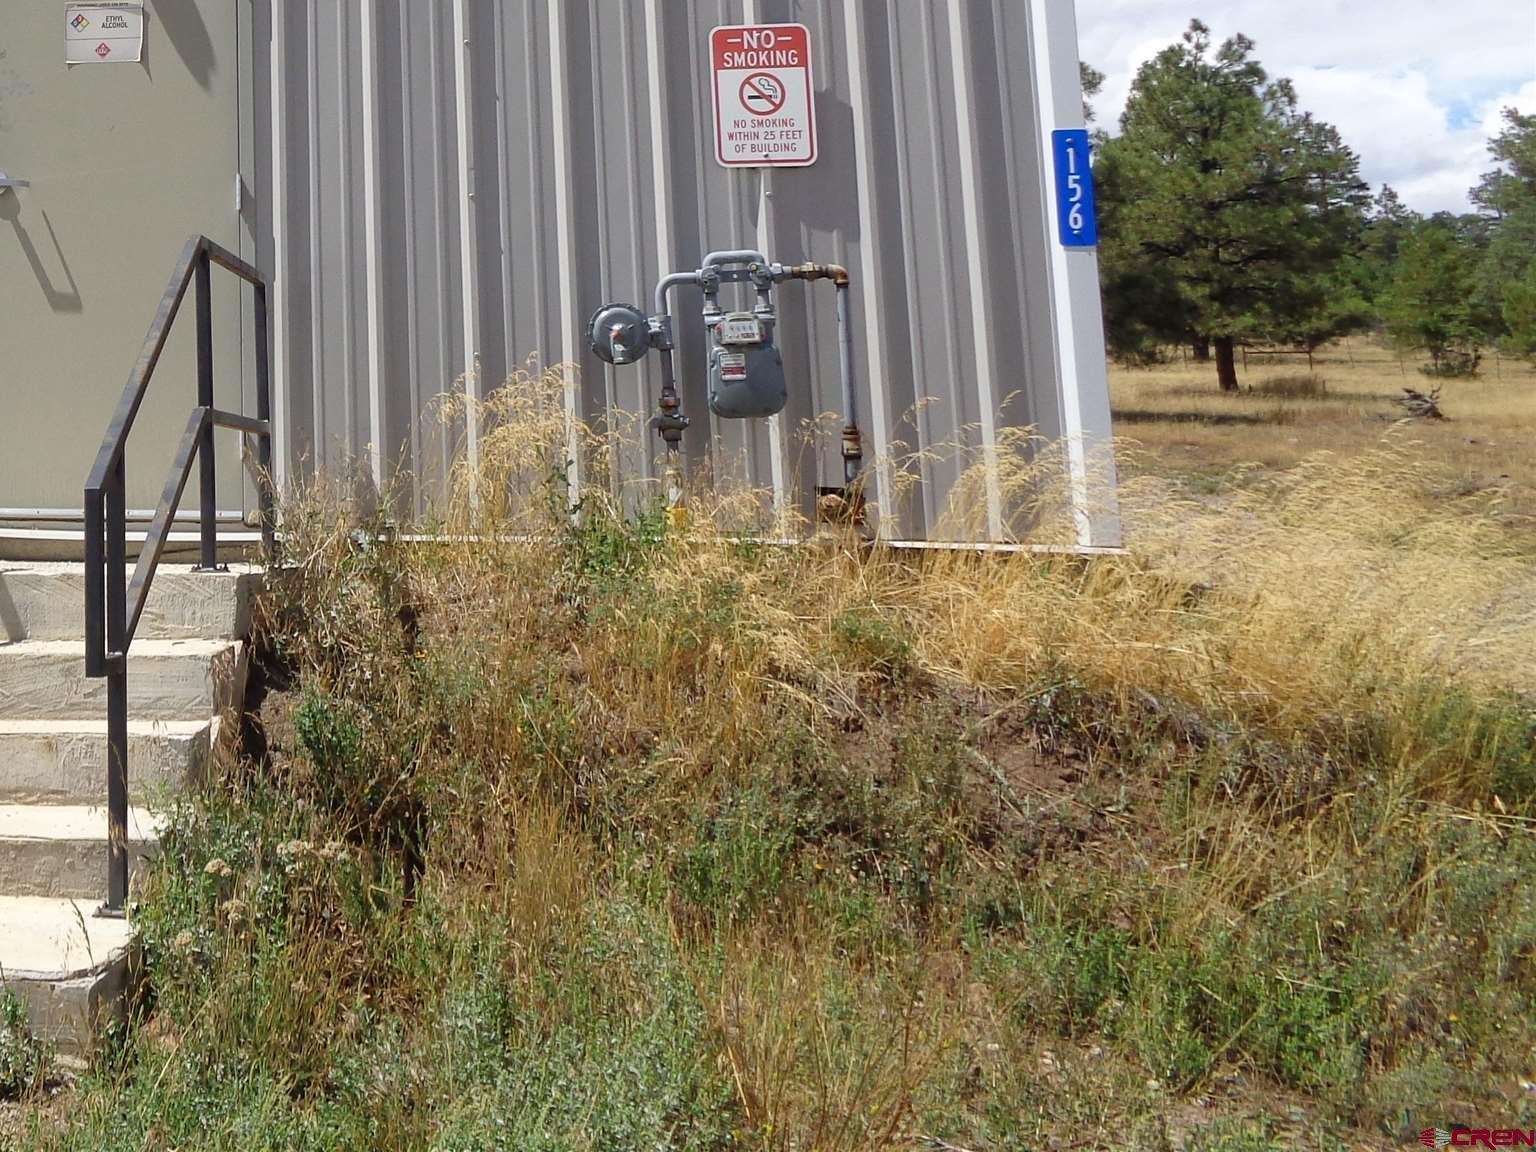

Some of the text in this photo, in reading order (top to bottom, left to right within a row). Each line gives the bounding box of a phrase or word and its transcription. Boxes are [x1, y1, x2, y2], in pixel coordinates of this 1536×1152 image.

[723, 49, 799, 68] SMOKING
[733, 118, 796, 129] NO SMOKING
[727, 130, 803, 141] WITHIN 25 FEET
[734, 143, 797, 153] OF BUILDING
[1065, 146, 1084, 230] 156
